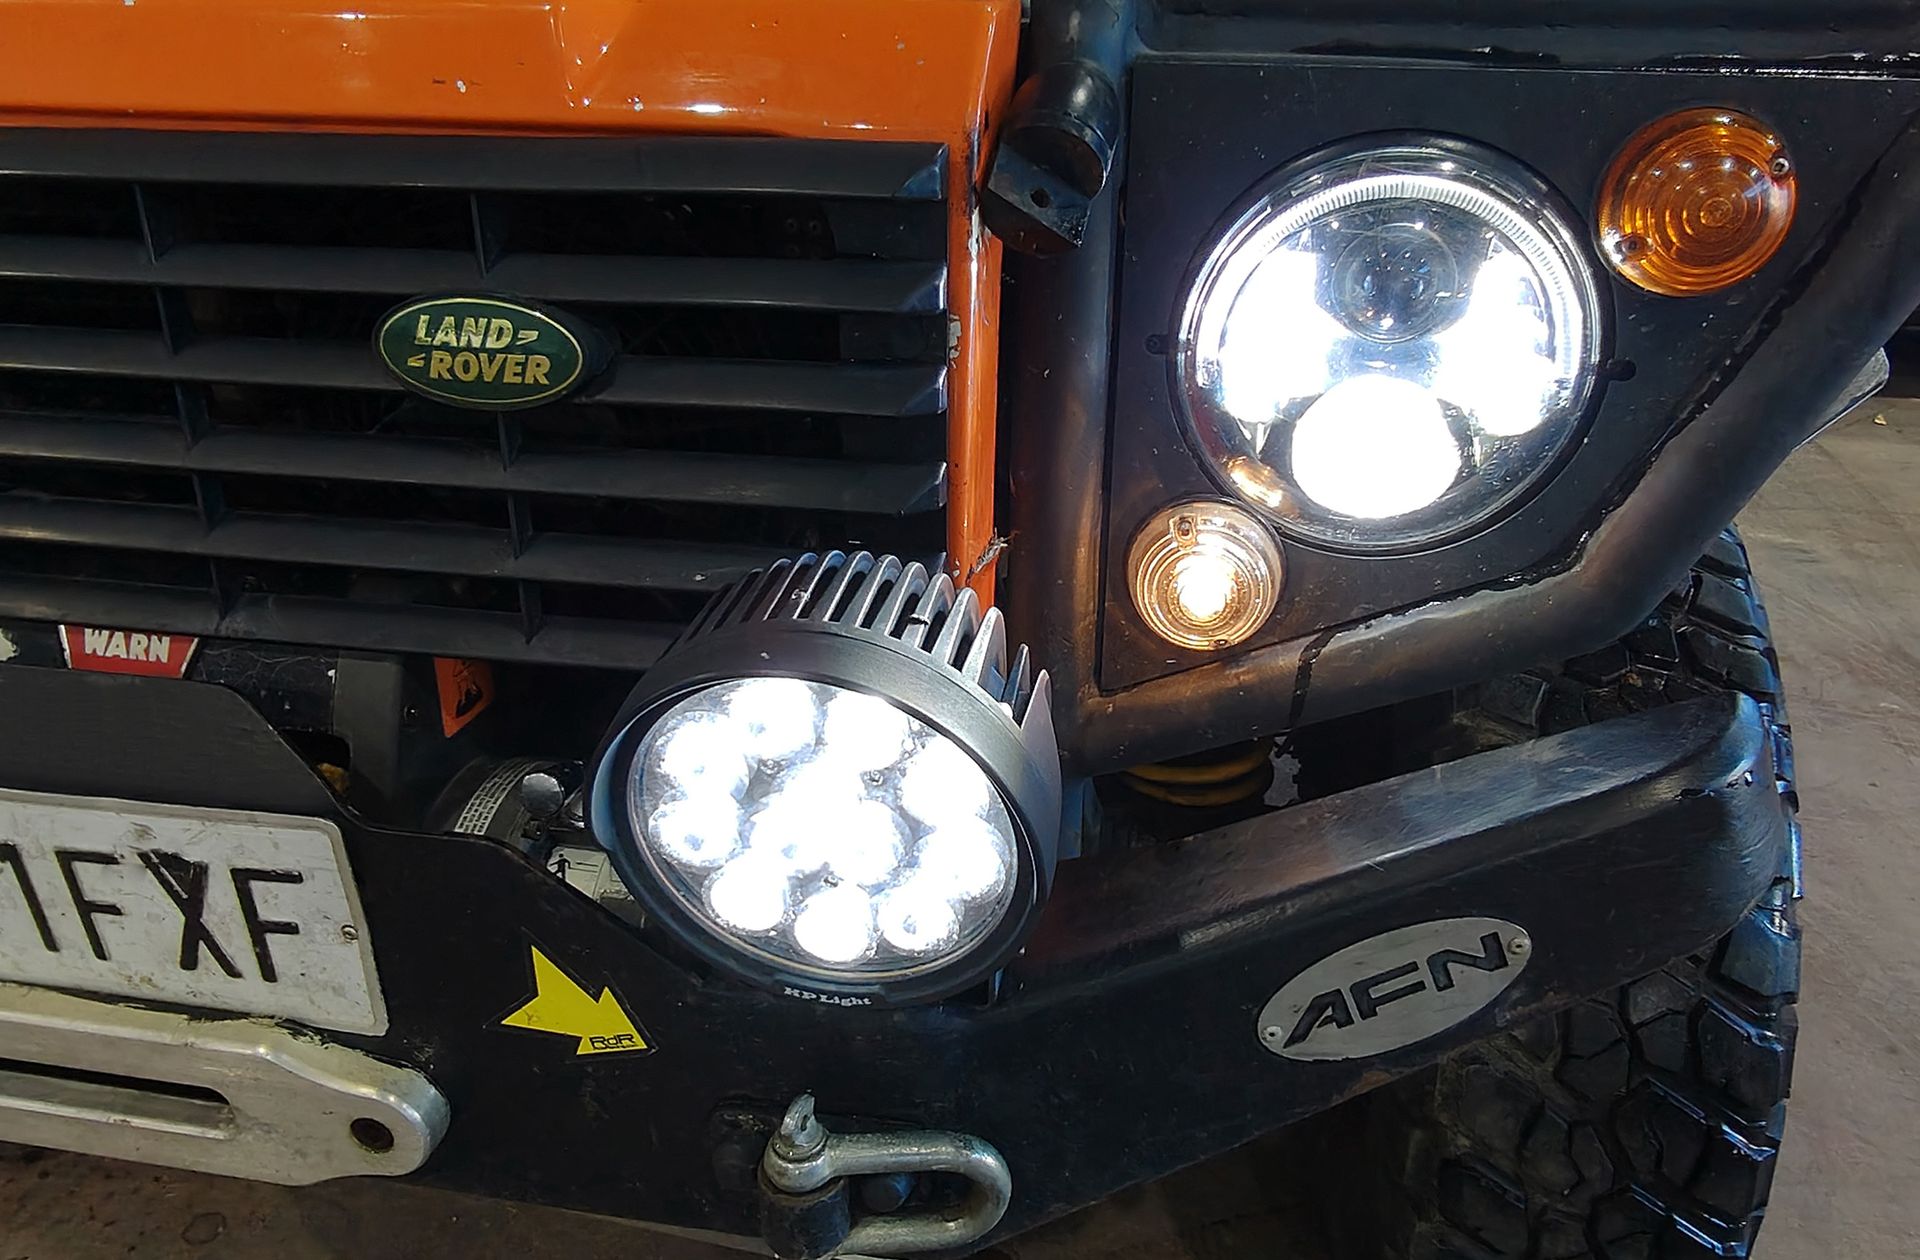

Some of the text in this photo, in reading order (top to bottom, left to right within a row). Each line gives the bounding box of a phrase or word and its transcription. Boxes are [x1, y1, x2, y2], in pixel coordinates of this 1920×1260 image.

[414, 314, 513, 349] LAND
[429, 350, 551, 385] ROVER
[84, 627, 170, 663] WARN
[1283, 931, 1509, 1050] AFN
